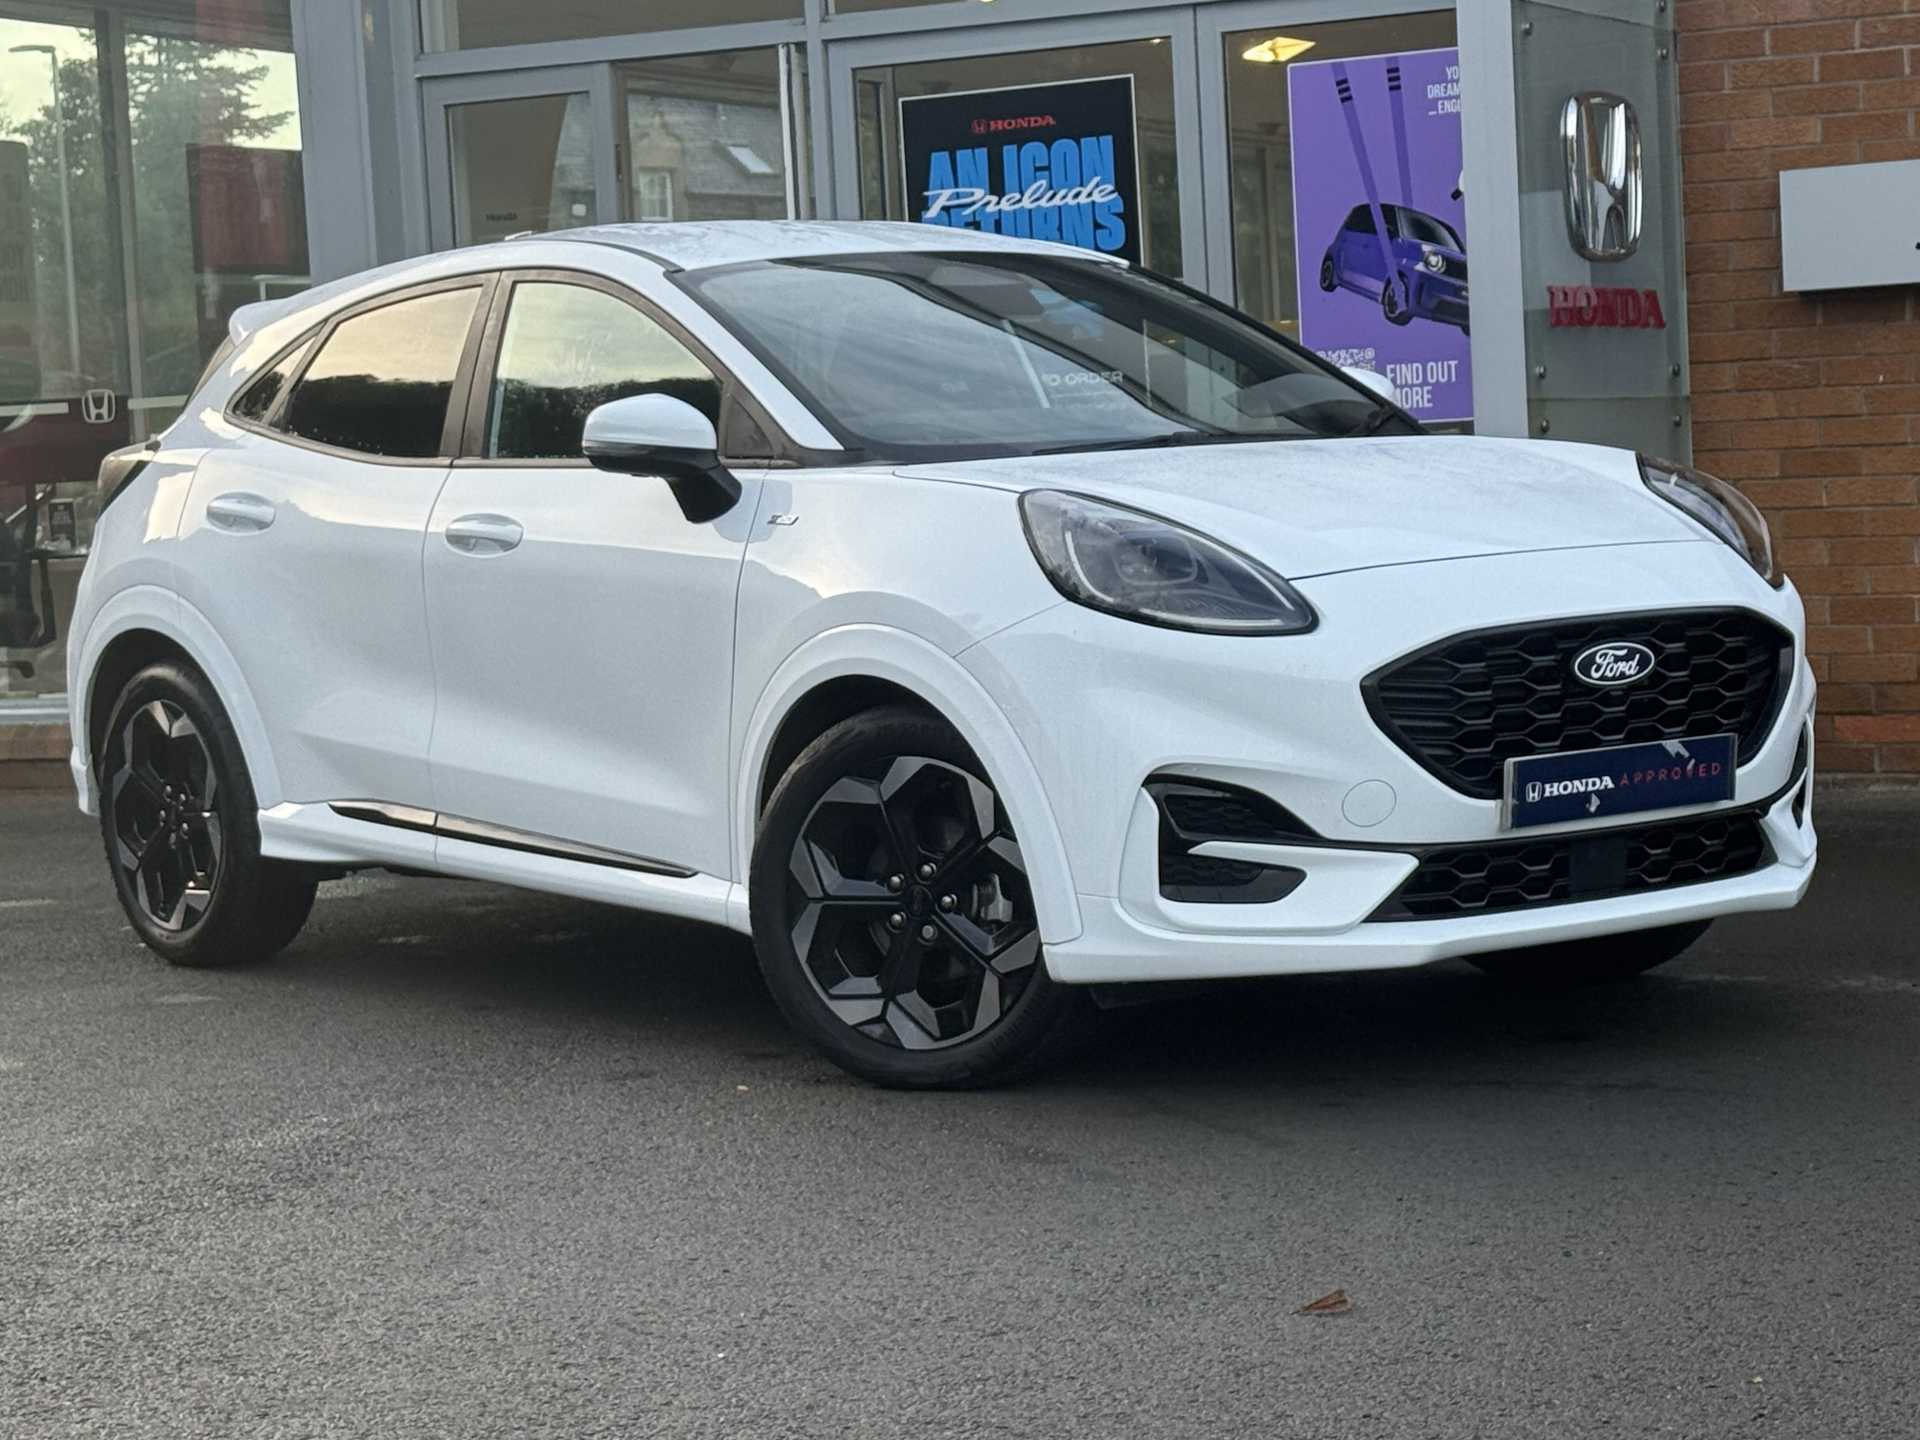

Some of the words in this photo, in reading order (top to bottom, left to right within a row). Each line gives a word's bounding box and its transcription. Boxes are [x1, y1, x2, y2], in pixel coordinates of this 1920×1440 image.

[989, 115, 1056, 131] HONDA
[928, 147, 990, 205] AN
[1003, 135, 1115, 197] ICON
[923, 176, 1119, 218] Prelude
[1547, 286, 1665, 328] HONDA
[1386, 362, 1422, 385] FIND
[1427, 360, 1458, 383] OUT
[1396, 386, 1433, 409] ORE
[1591, 649, 1640, 679] Ford
[1544, 776, 1614, 797] HONDA
